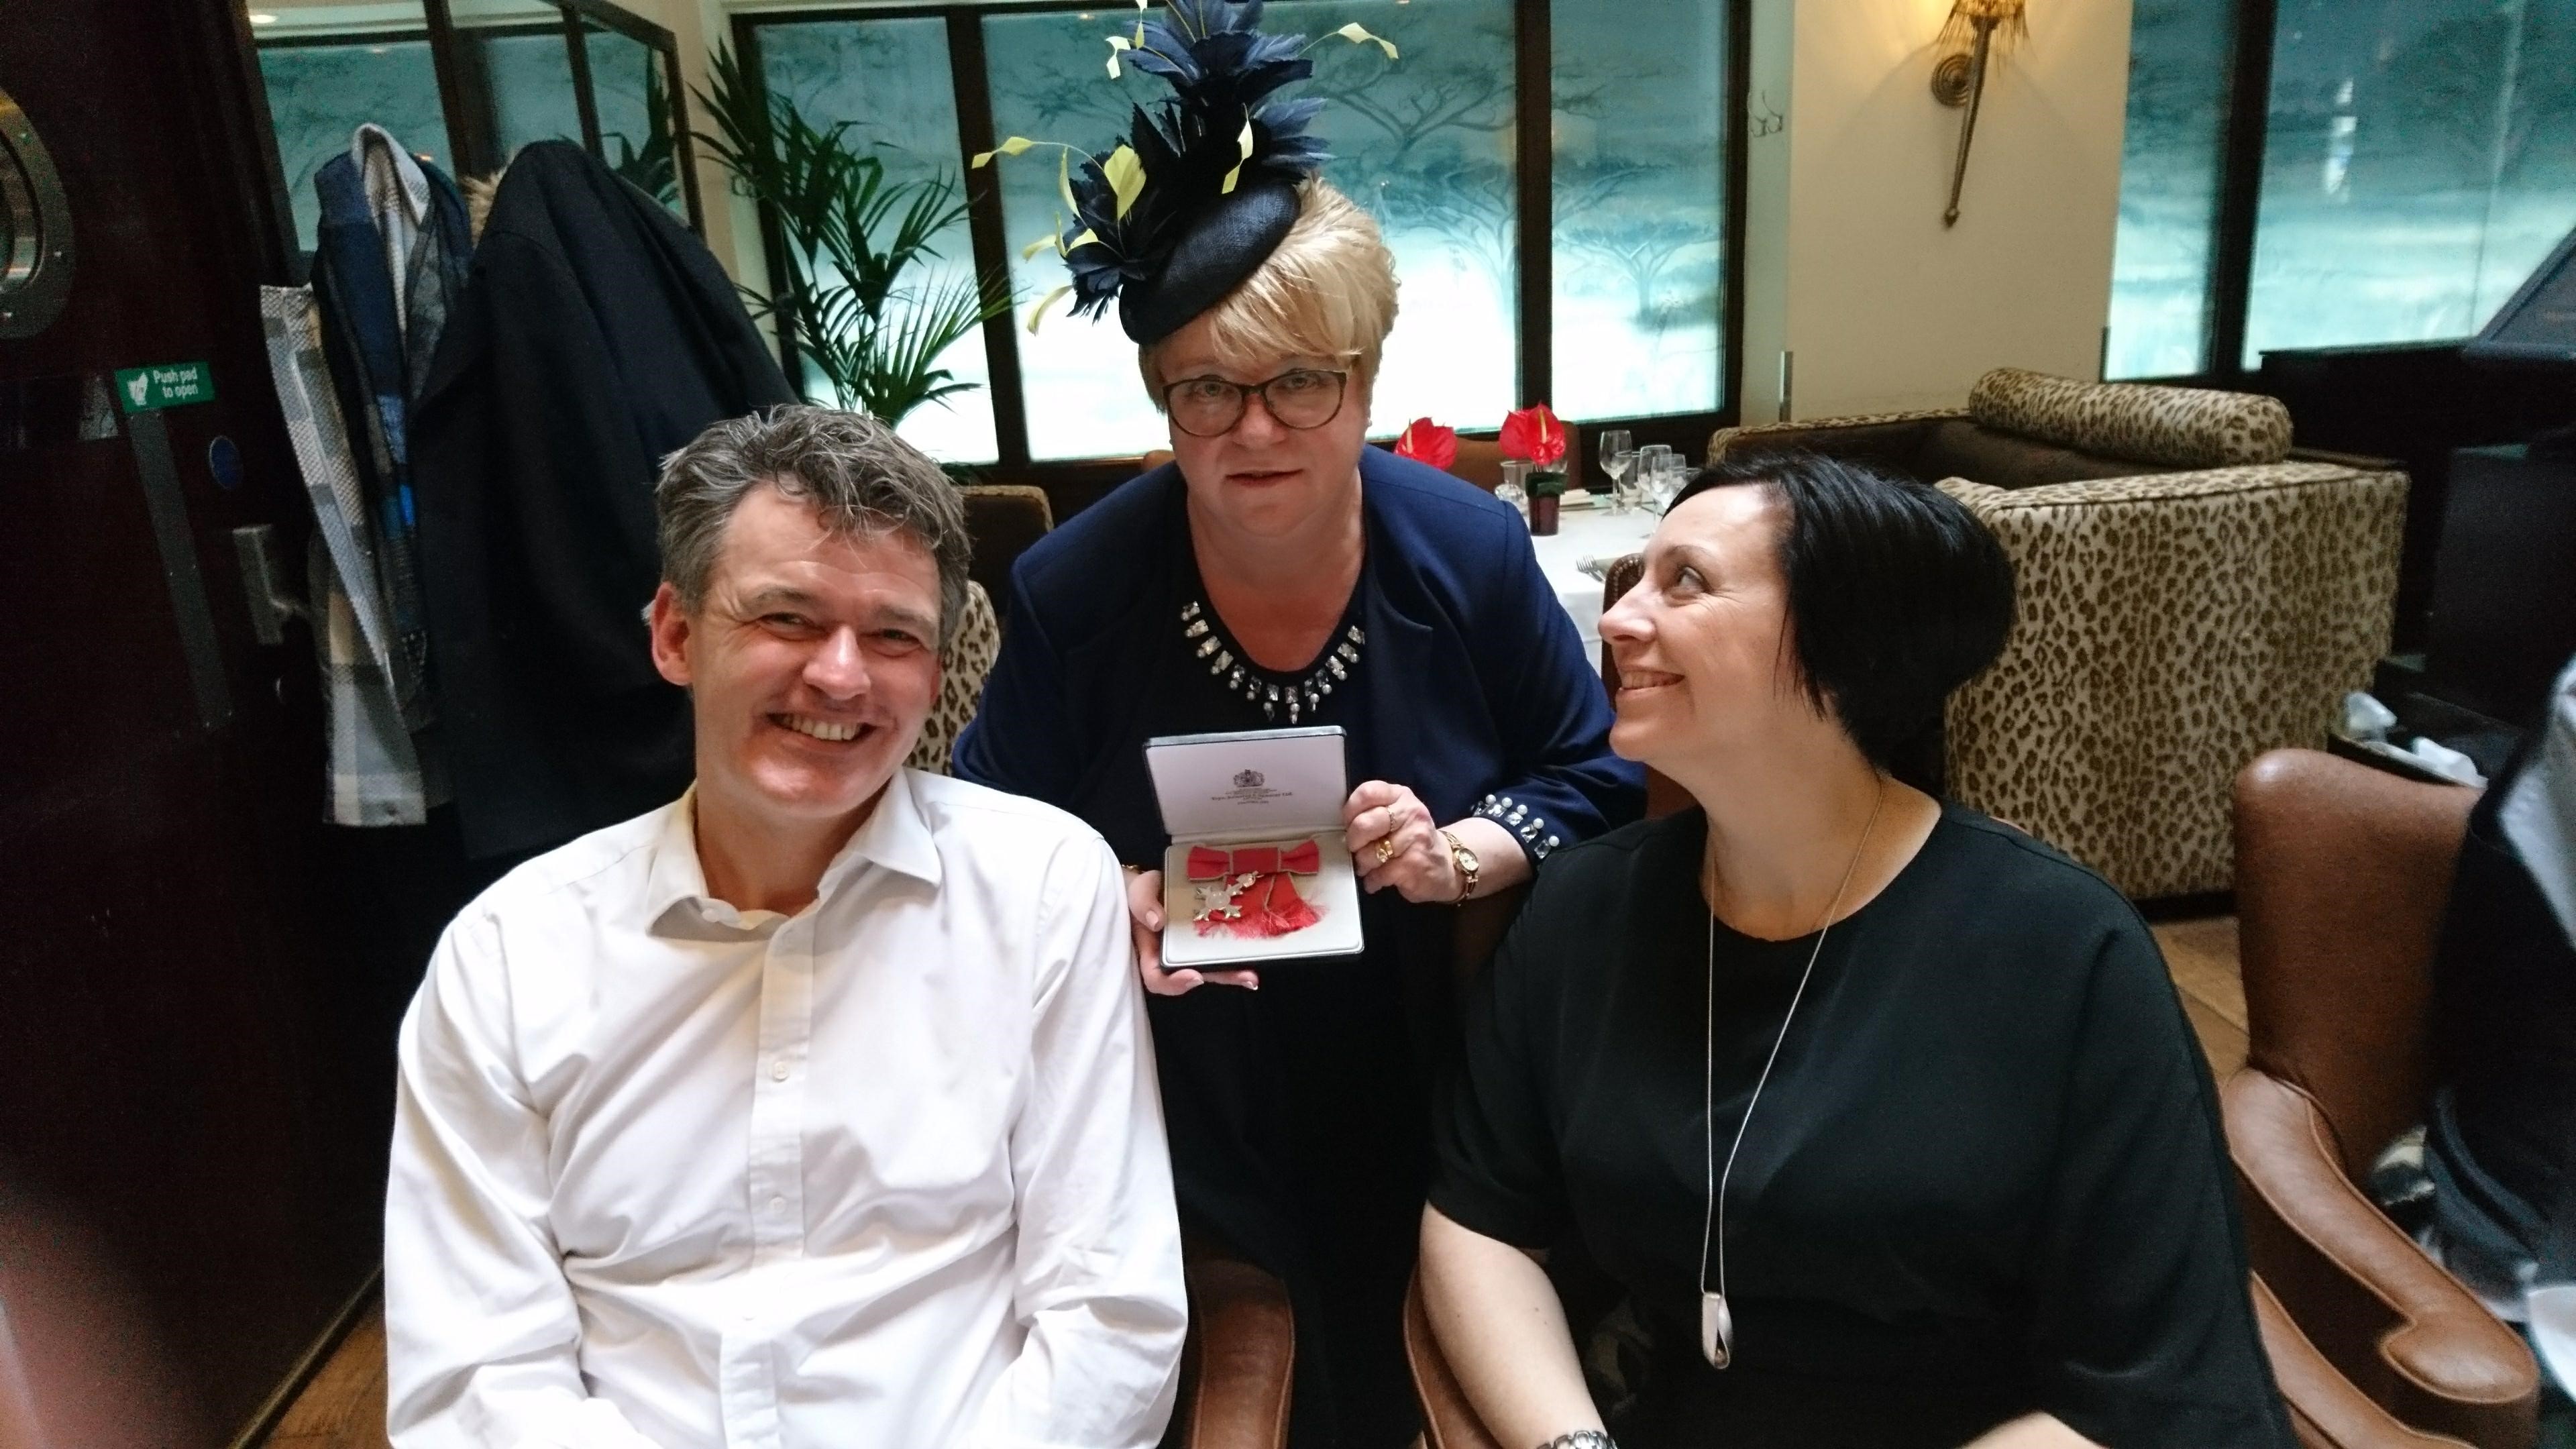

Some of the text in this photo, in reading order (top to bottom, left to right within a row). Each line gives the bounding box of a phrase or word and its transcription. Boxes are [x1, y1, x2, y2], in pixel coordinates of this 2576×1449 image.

[153, 367, 198, 384] Push pad
[162, 384, 199, 399] to open
